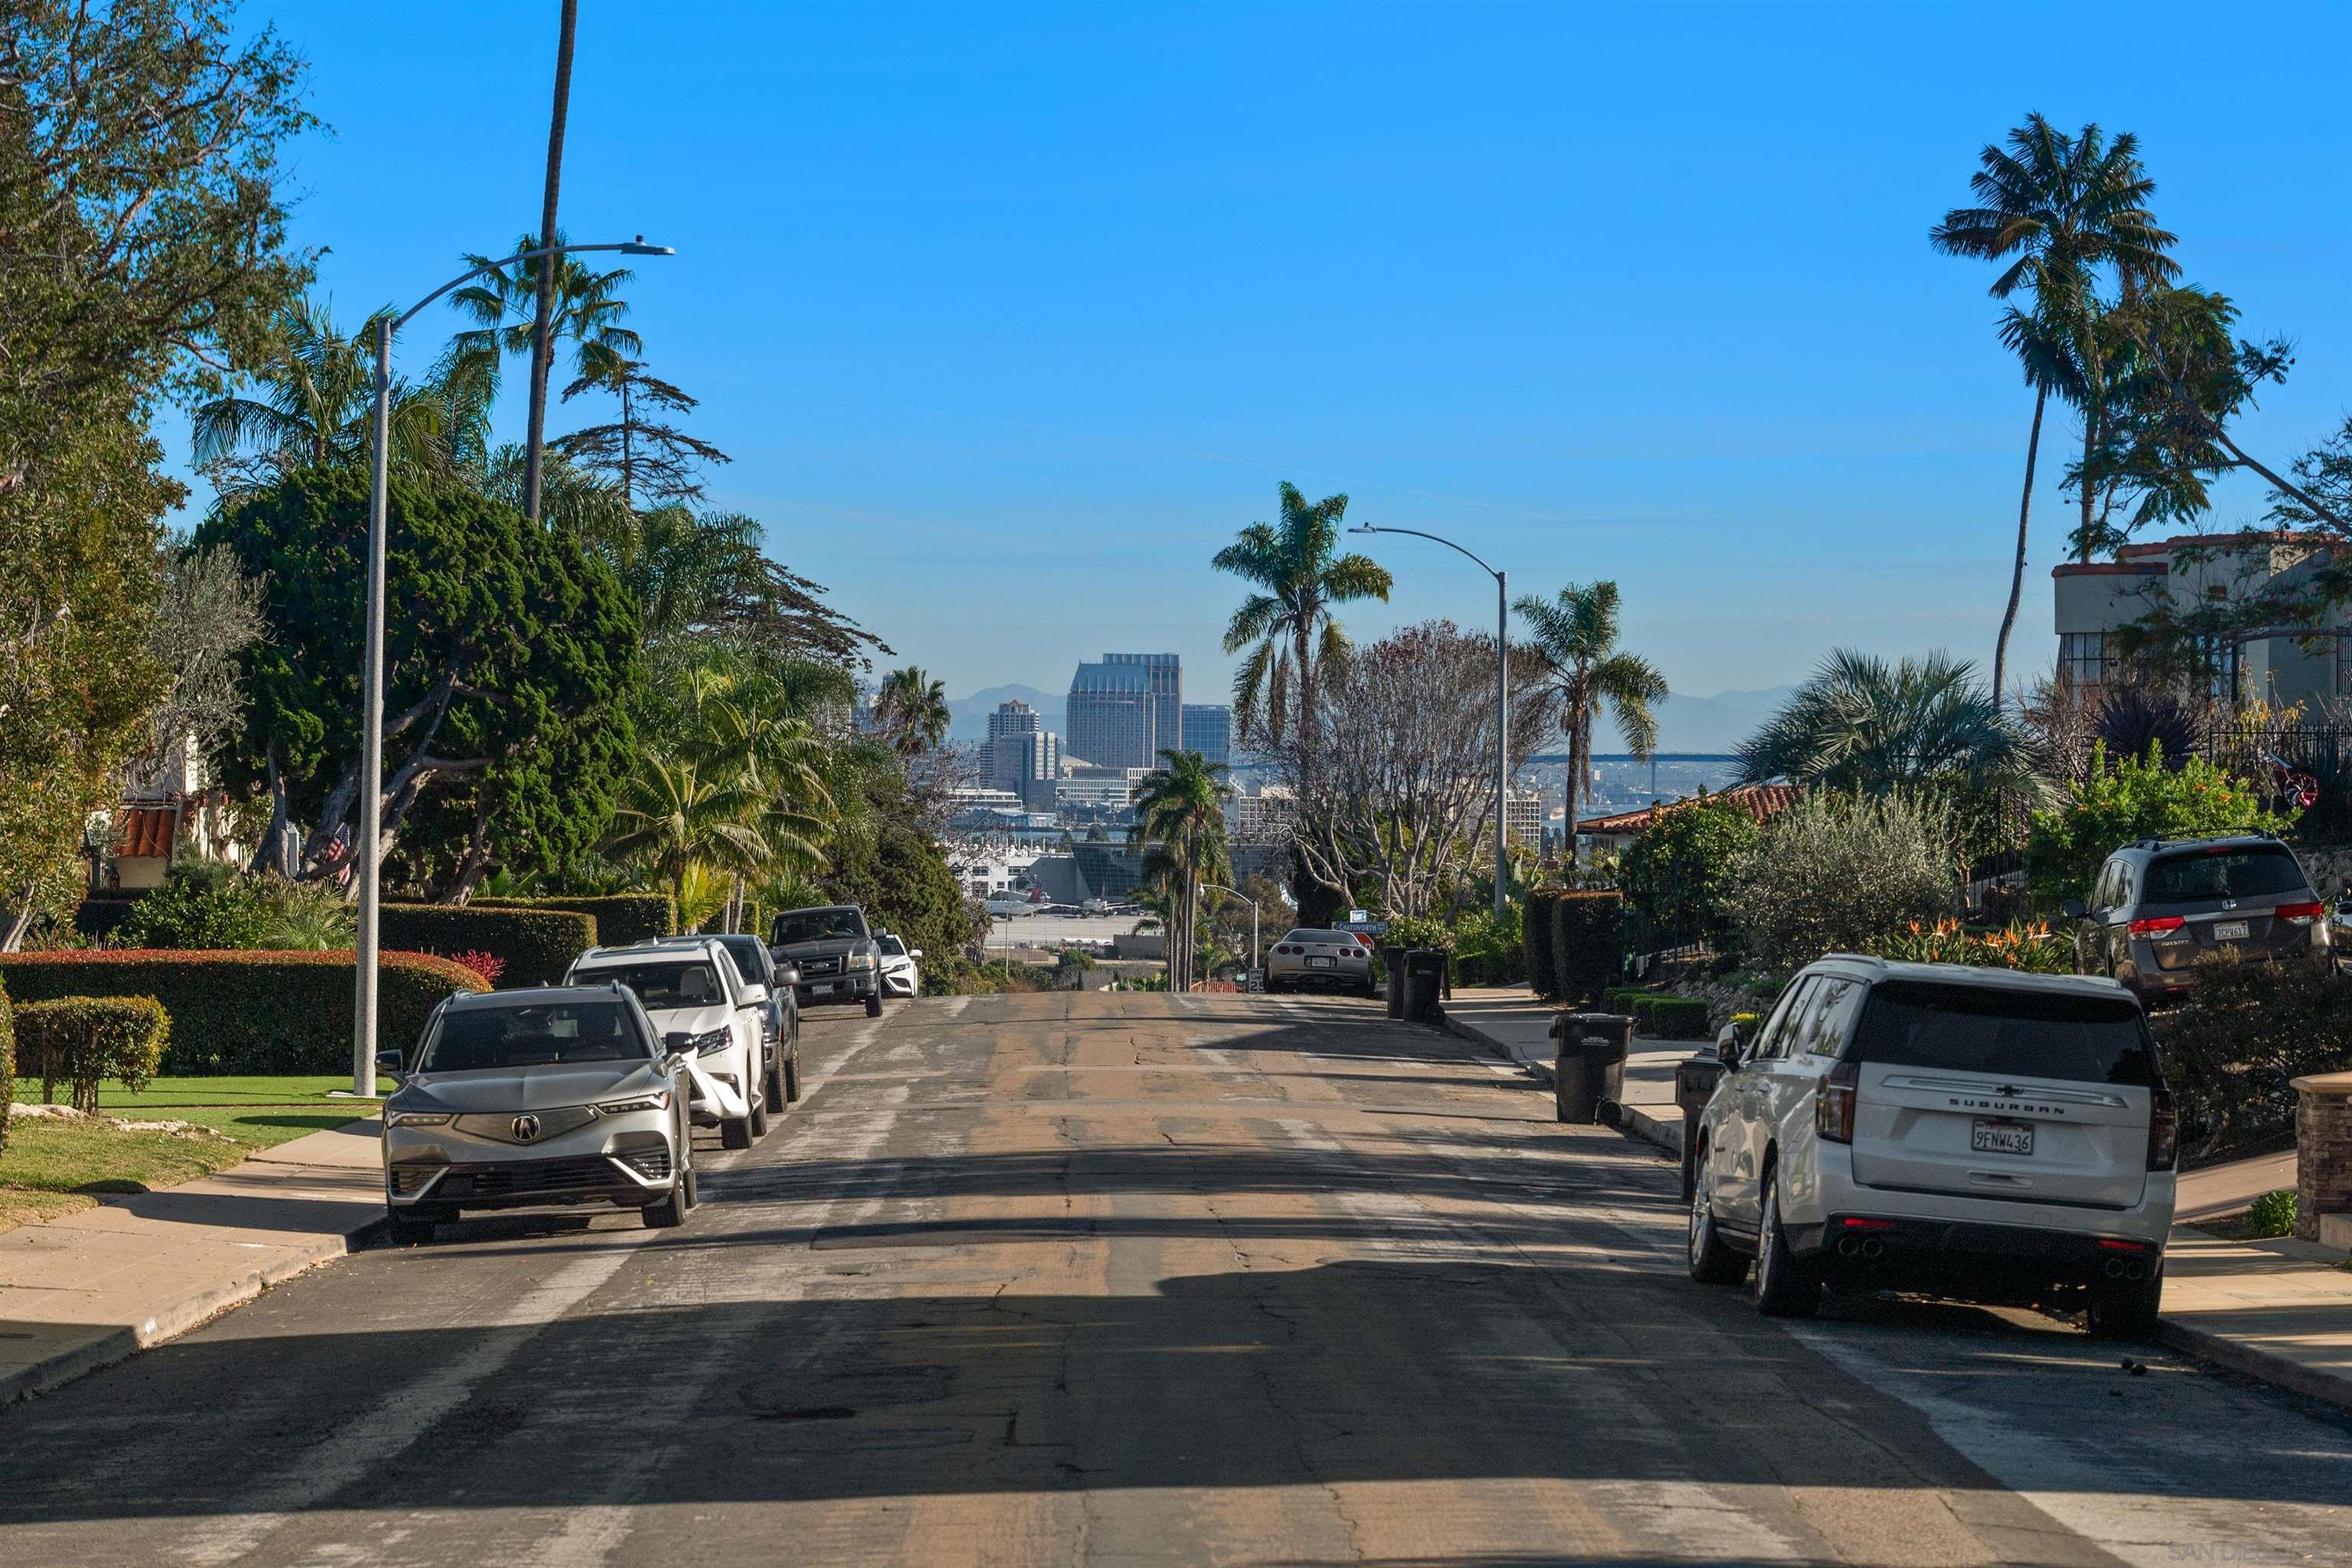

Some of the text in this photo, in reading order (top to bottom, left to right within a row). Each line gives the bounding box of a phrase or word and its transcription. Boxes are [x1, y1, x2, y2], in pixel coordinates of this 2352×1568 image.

[1339, 923, 1377, 932] CHATSWORTH
[2216, 926, 2247, 939] 7CPV617
[1949, 1099, 2065, 1115] SUBURBAN
[1975, 1131, 2030, 1150] 9FNW436
